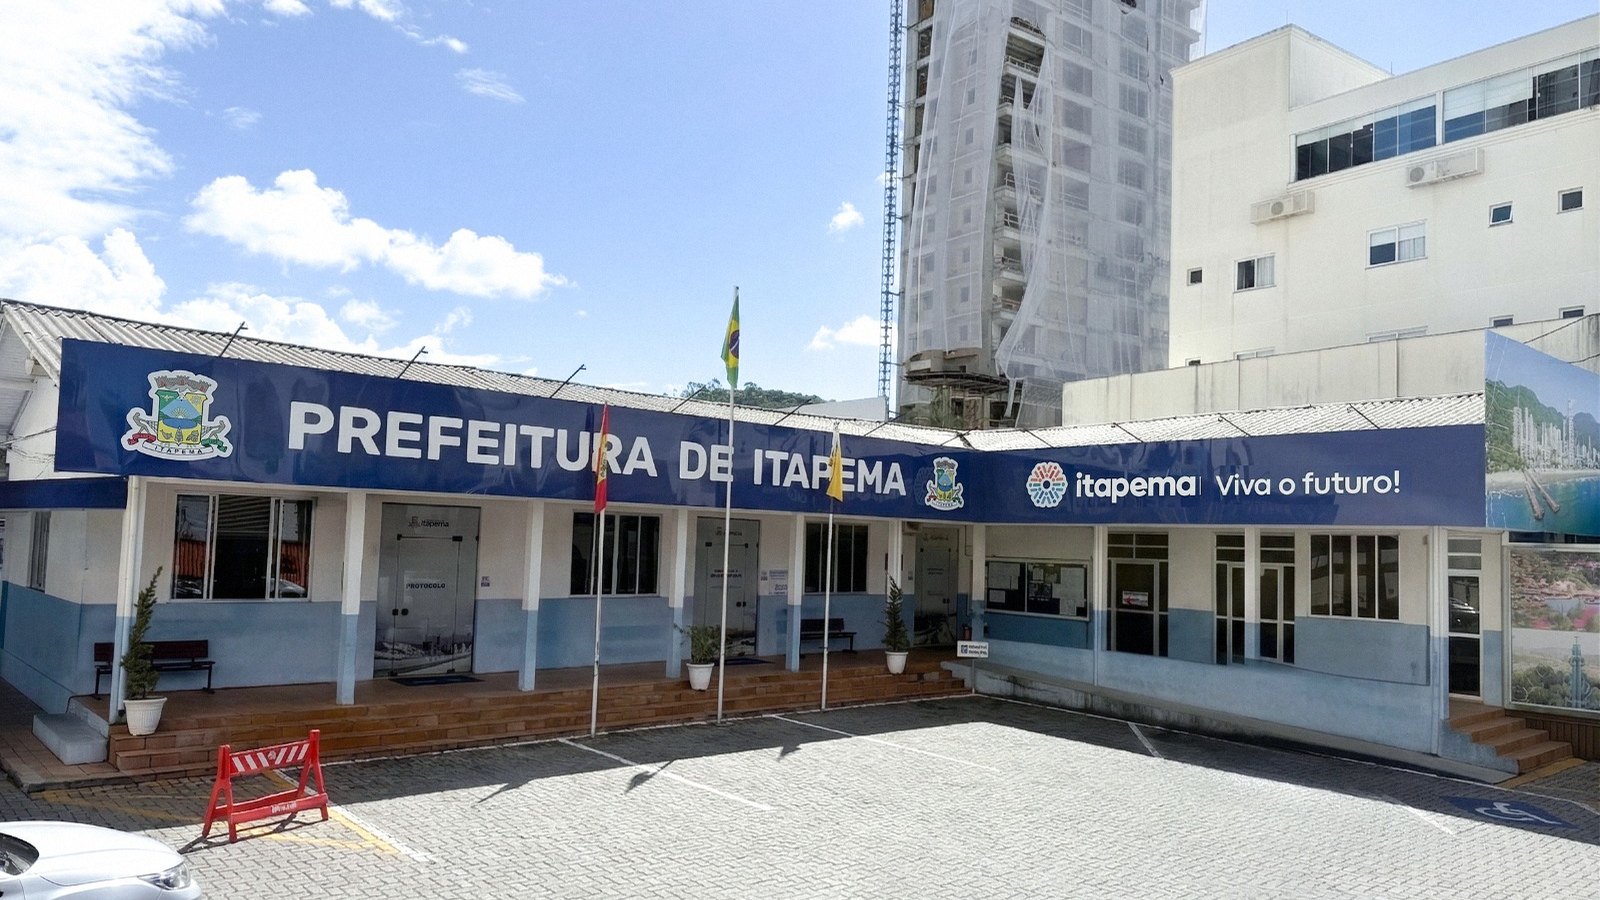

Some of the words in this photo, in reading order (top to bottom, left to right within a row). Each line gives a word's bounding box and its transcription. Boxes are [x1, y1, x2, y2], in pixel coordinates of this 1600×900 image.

[154, 445, 204, 455] ITAPEMA
[288, 401, 658, 477] PREFEITURA
[679, 440, 735, 482] DE
[753, 448, 907, 496] ITAPEMA
[1075, 471, 1196, 503] itapema
[1215, 473, 1271, 496] Viva
[1278, 477, 1296, 495] o
[1302, 470, 1400, 495] futuro!
[405, 582, 446, 590] PROTOCOLO
